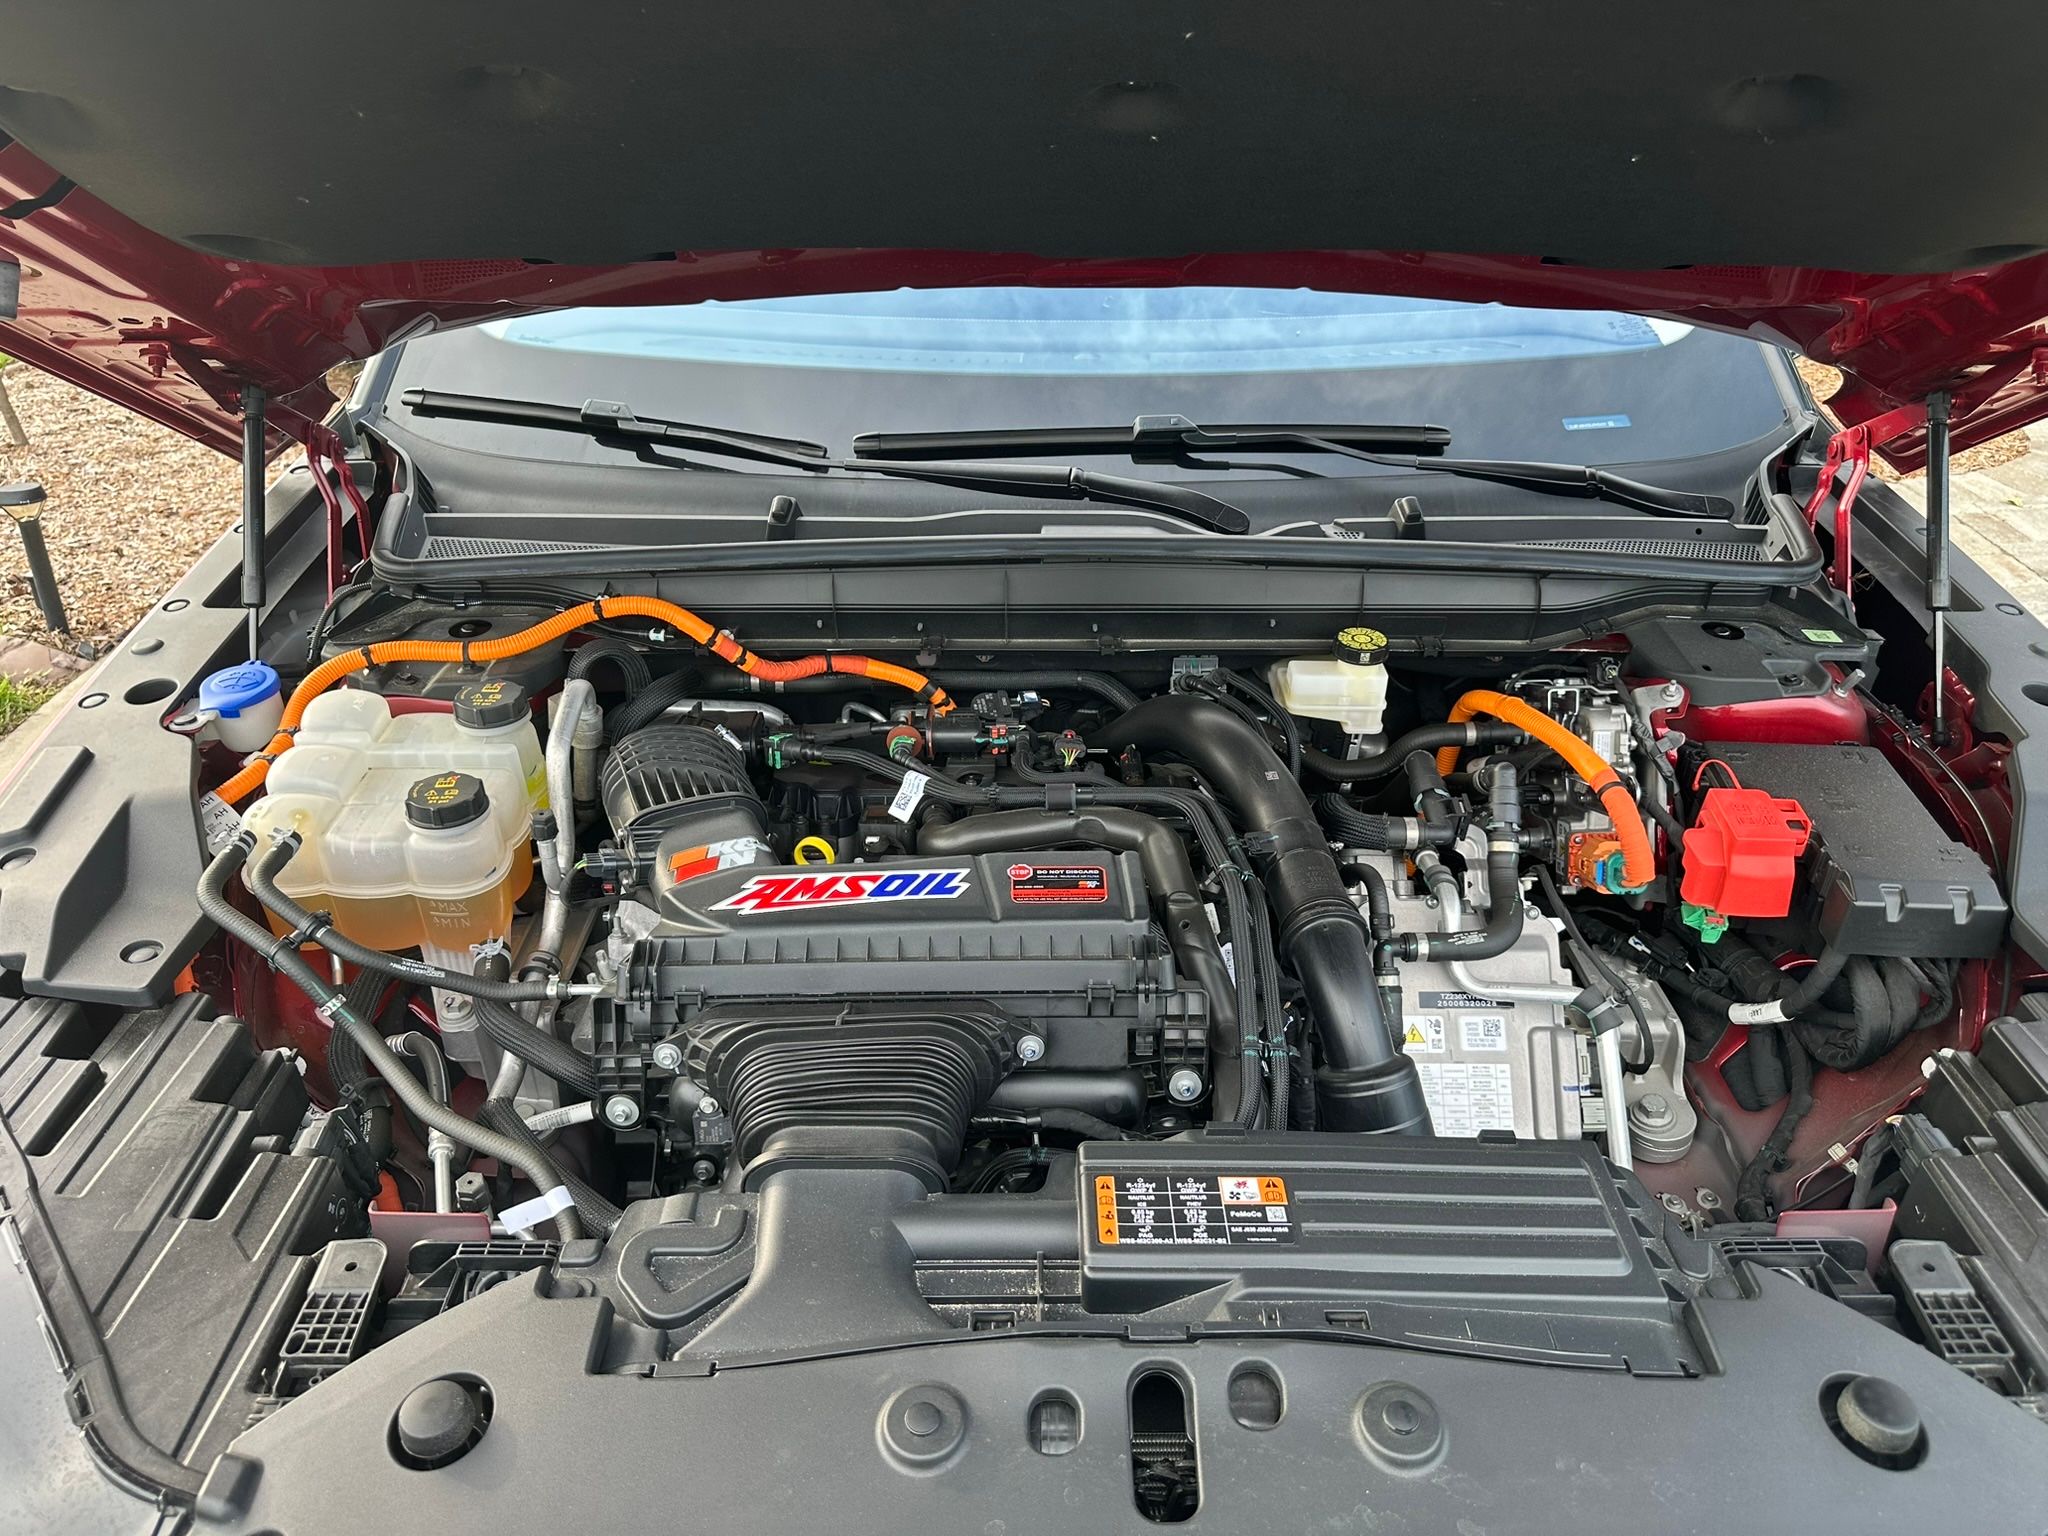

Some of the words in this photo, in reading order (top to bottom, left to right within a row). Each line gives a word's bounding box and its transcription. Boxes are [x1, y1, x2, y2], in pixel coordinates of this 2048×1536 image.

[200, 796, 215, 808] AH
[214, 807, 228, 819] AH
[728, 872, 964, 911] AMSOIL
[438, 901, 468, 913] MAX
[440, 918, 471, 929] MIN
